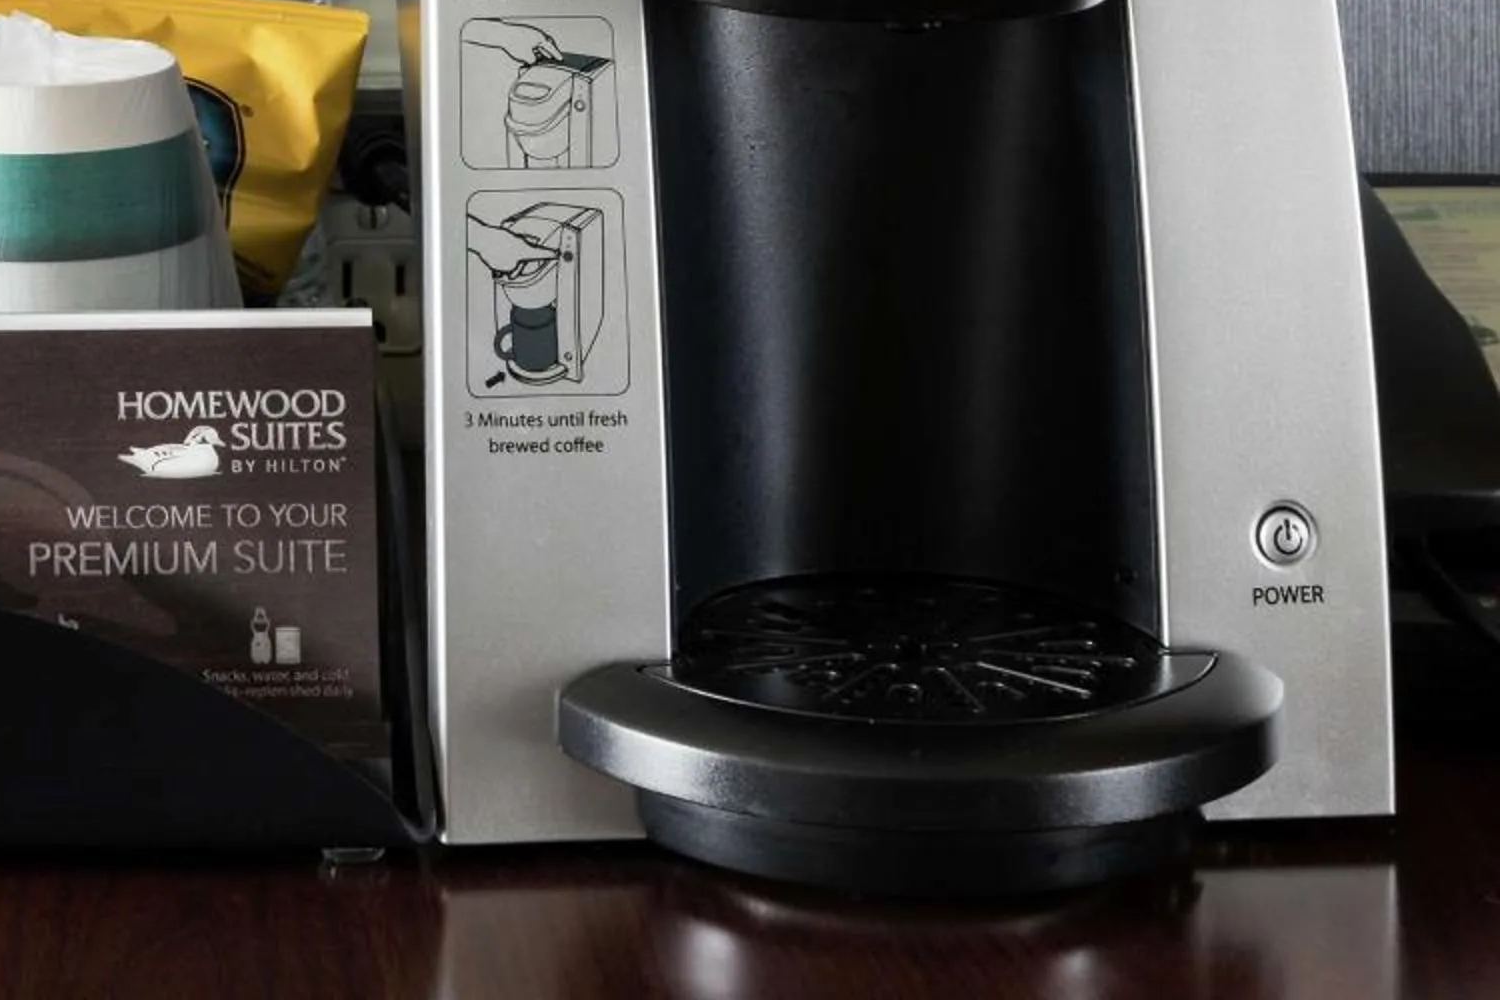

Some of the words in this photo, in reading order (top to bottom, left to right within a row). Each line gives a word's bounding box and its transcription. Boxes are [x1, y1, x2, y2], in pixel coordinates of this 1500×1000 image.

[117, 389, 347, 420] HOMEWOOD
[464, 411, 474, 429] 3
[478, 411, 543, 428] Minutes
[547, 411, 585, 428] until
[588, 410, 628, 427] fresh
[230, 421, 347, 451] SUITES
[488, 437, 550, 453] brewed
[554, 436, 605, 453] coffee
[231, 459, 255, 473] BY
[265, 458, 342, 473] HILTON
[65, 504, 214, 530] WELCOME
[220, 503, 261, 528] TO
[268, 503, 348, 528] YOUR
[29, 540, 218, 577] PREMIUM
[233, 539, 348, 575] SUITE
[1252, 585, 1325, 607] POWER
